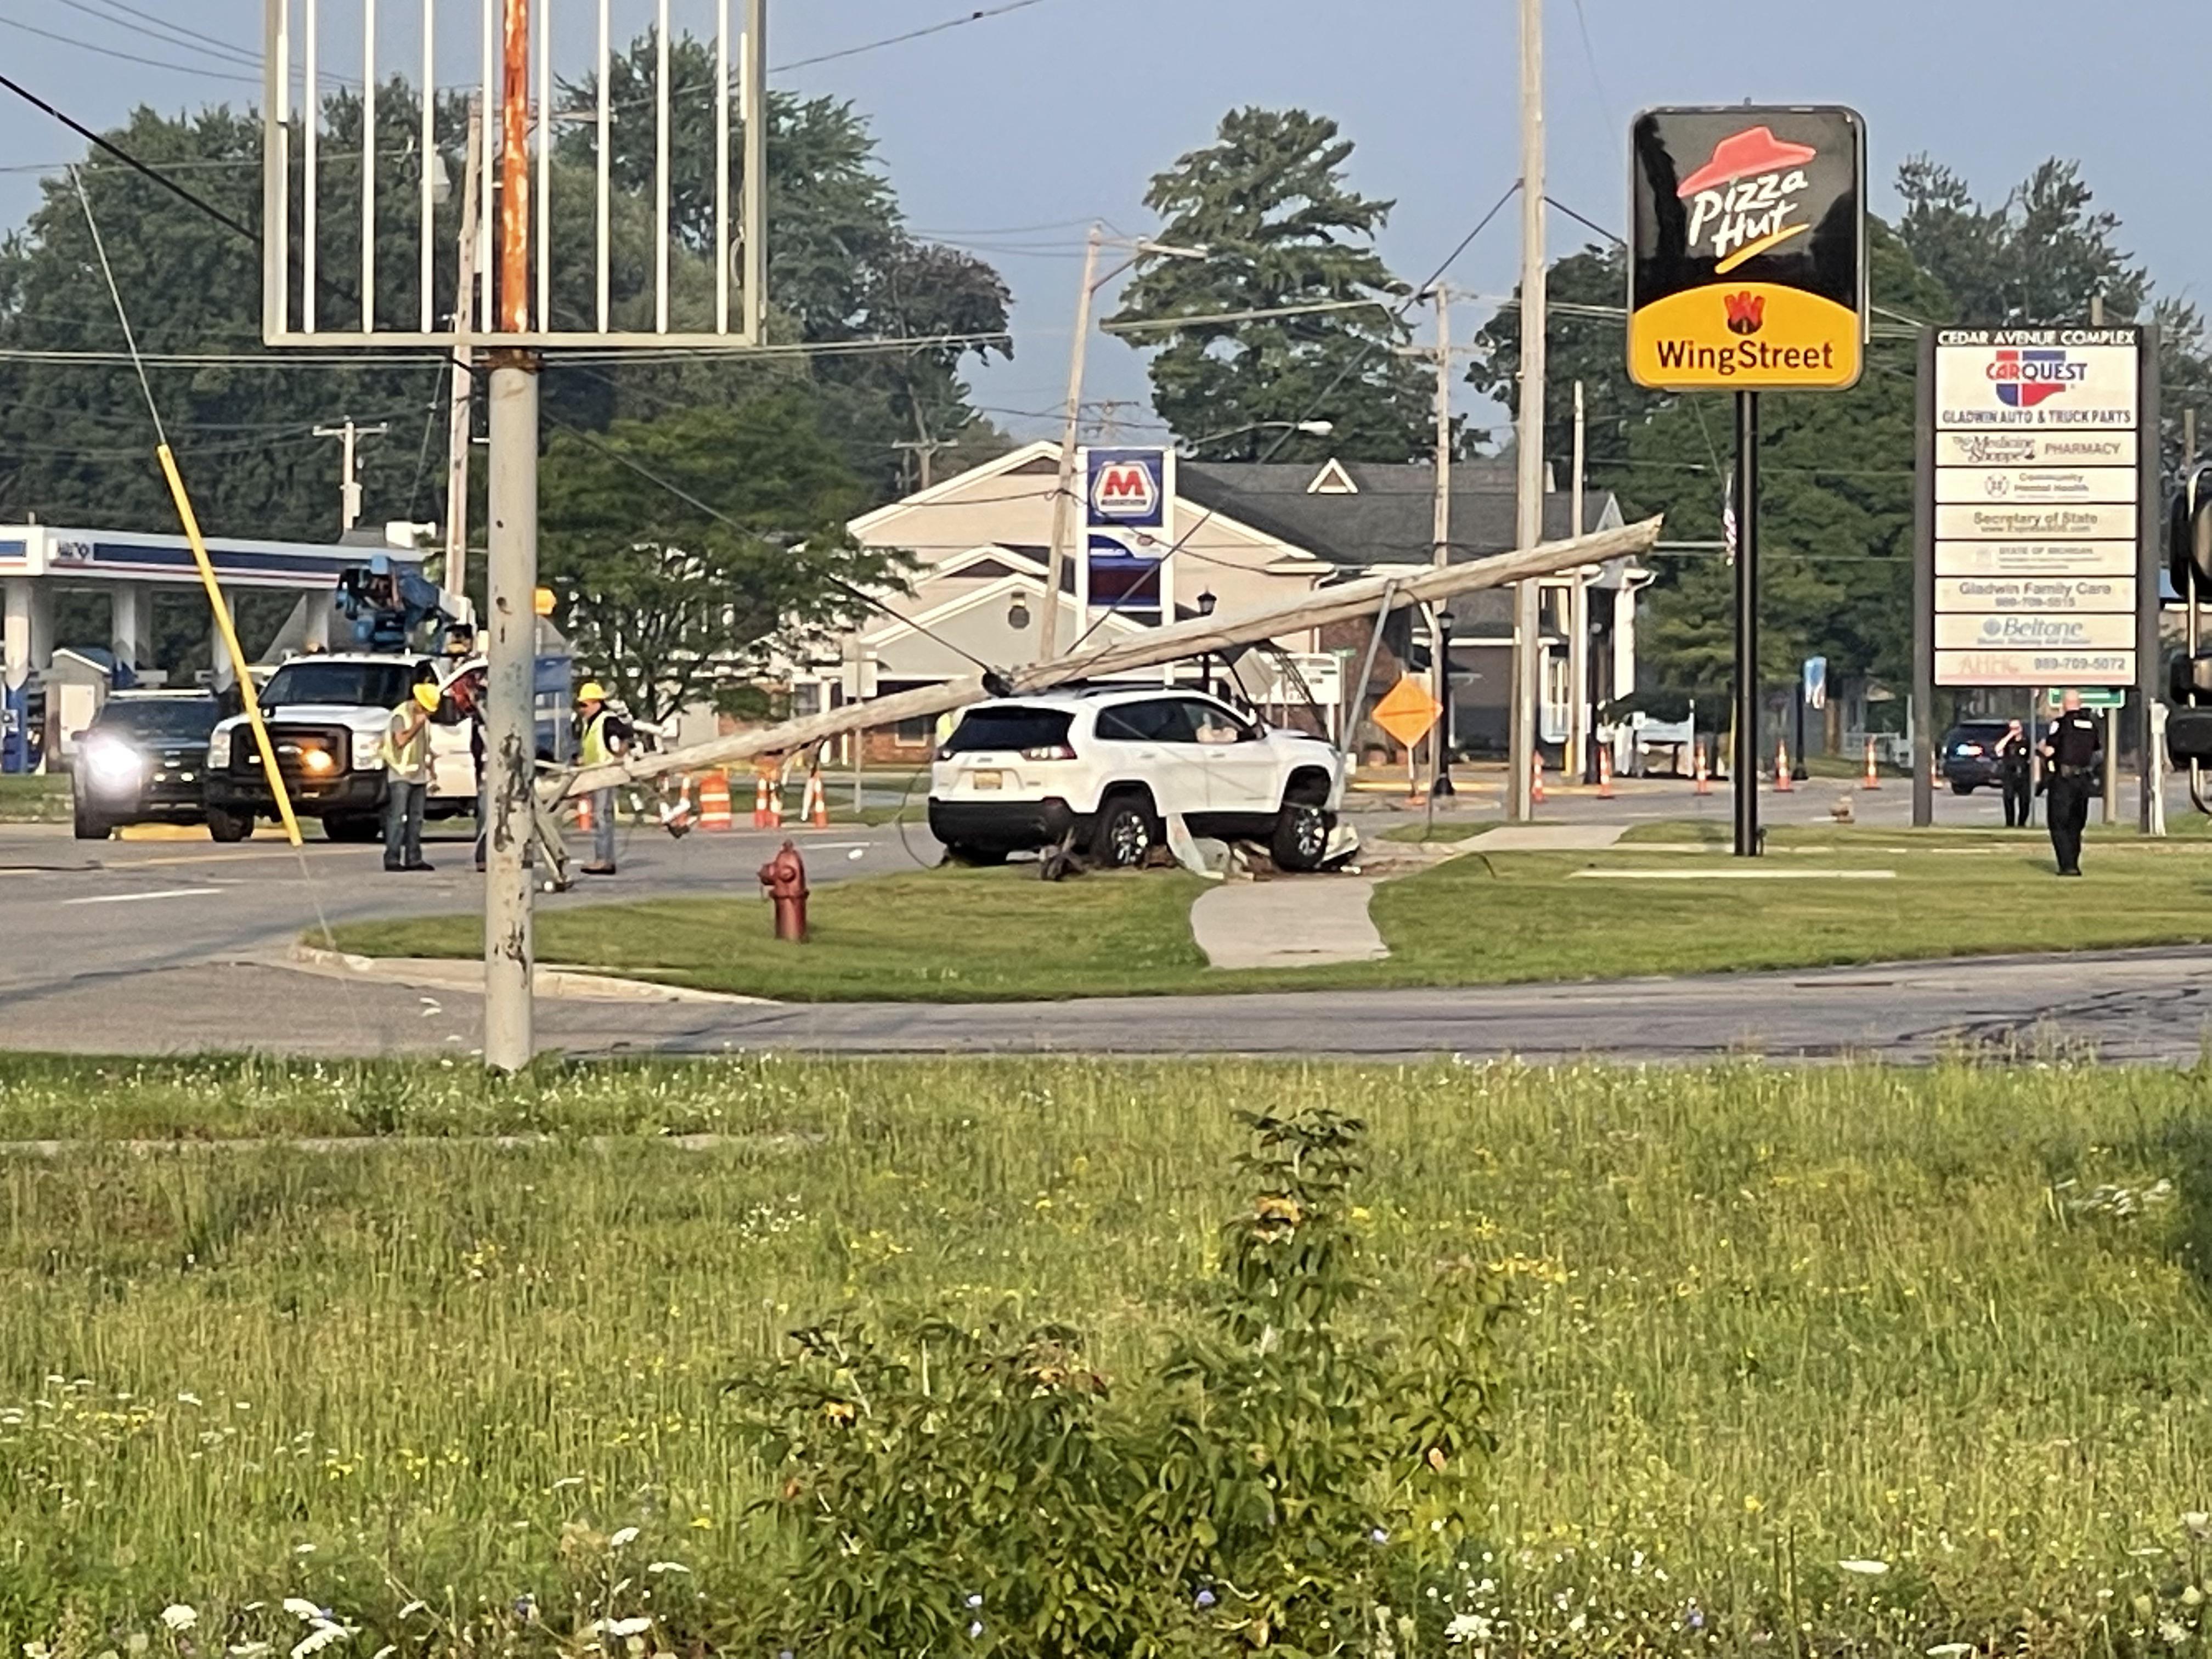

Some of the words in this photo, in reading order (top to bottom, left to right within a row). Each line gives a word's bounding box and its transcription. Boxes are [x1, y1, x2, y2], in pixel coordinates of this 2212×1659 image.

[1688, 170, 1809, 246] Pizza
[1711, 202, 1798, 258] Hut
[1937, 330, 1989, 345] CEDAR
[1994, 330, 2056, 345] AVENUE
[2060, 330, 2135, 345] COMPLEX
[1657, 340, 1833, 376] WingStreet
[1985, 363, 2088, 380] CARQUEST
[2000, 410, 2033, 424] AUTO
[2038, 410, 2046, 424] &
[2049, 410, 2089, 424] TRUCK
[2092, 410, 2131, 424] PARTS
[2045, 442, 2121, 455] PHARMACY
[1103, 471, 1146, 496] M
[1959, 582, 2020, 595] Gladwin
[2024, 582, 2073, 597] Family
[2076, 582, 2112, 595] Care
[2002, 617, 2084, 636] Beltone
